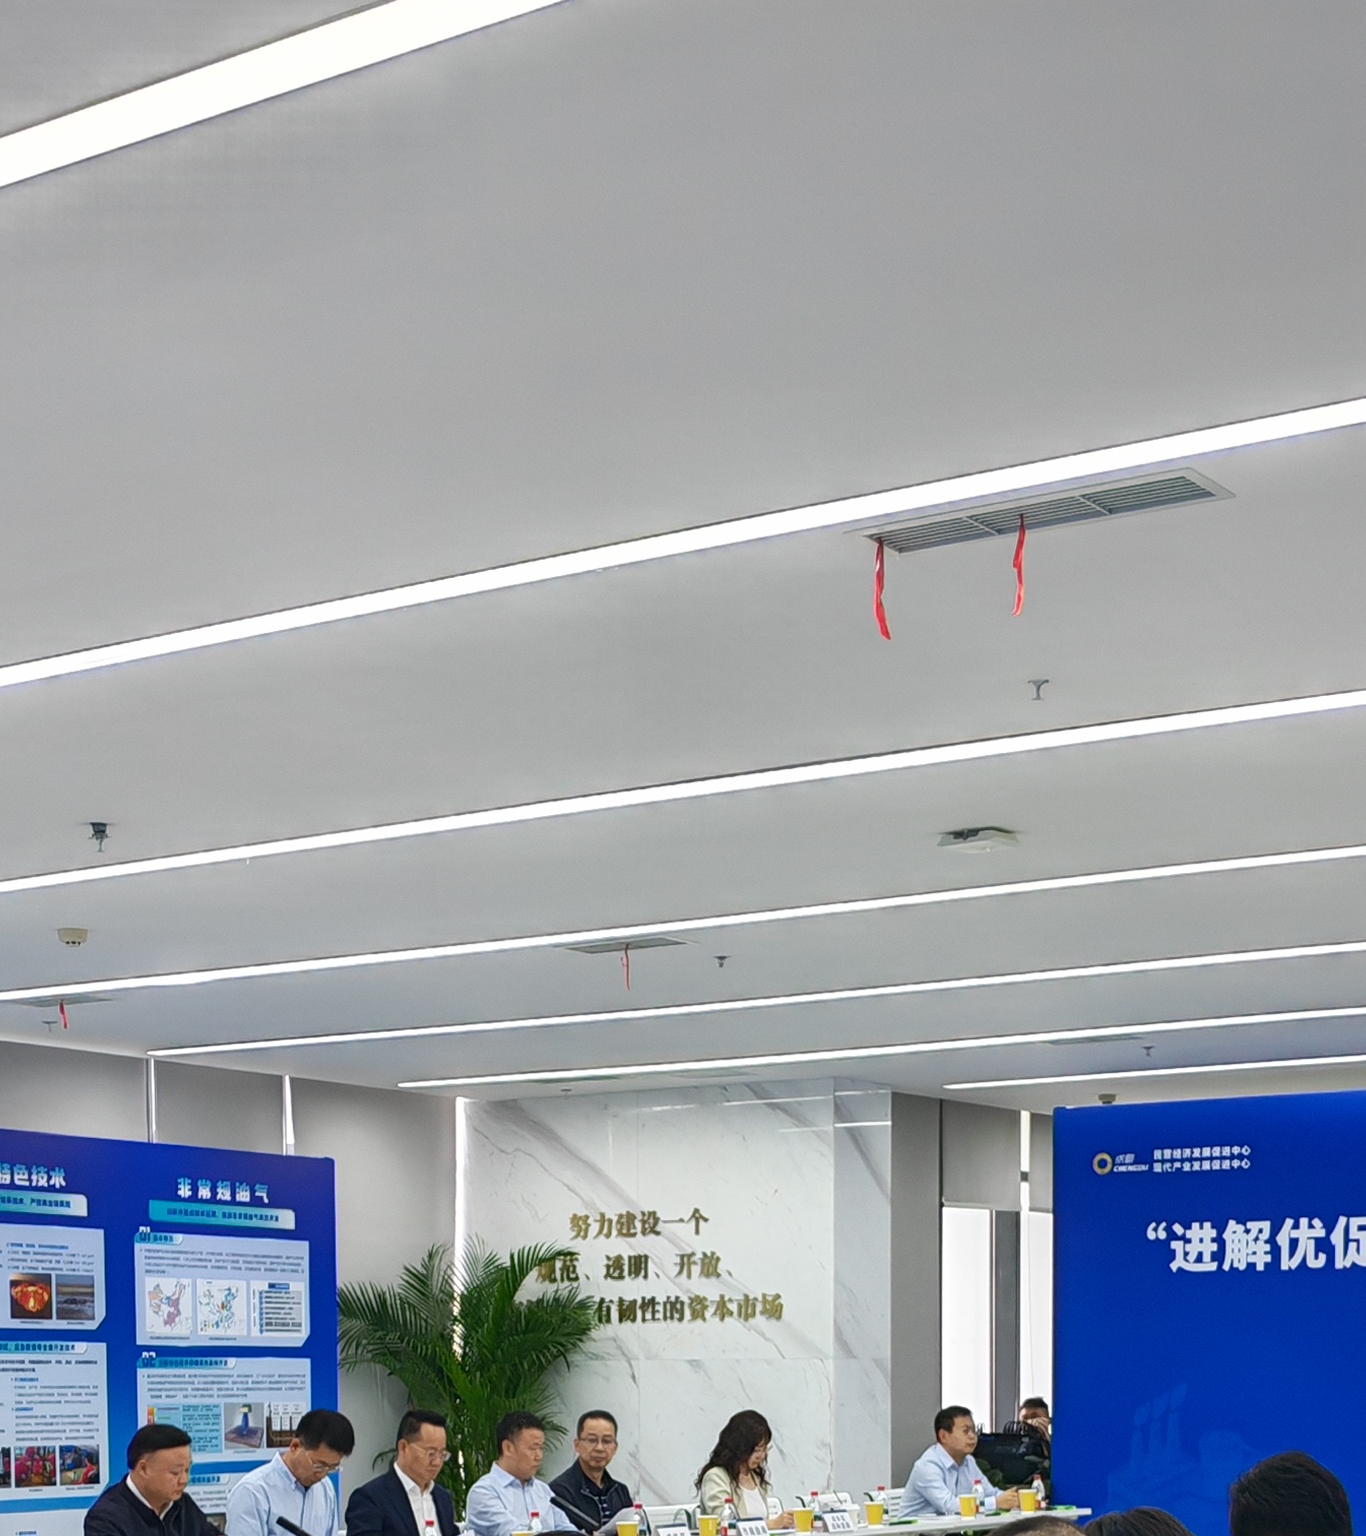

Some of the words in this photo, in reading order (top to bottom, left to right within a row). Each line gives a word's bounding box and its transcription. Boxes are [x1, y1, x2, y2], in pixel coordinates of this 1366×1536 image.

[1153, 1145, 1251, 1160] 民营经济发展促进中心
[1153, 1158, 1251, 1173] 现代产业发展促进中心
[177, 1177, 269, 1204] 非常规油气
[569, 1208, 710, 1240] 努力建设一个
